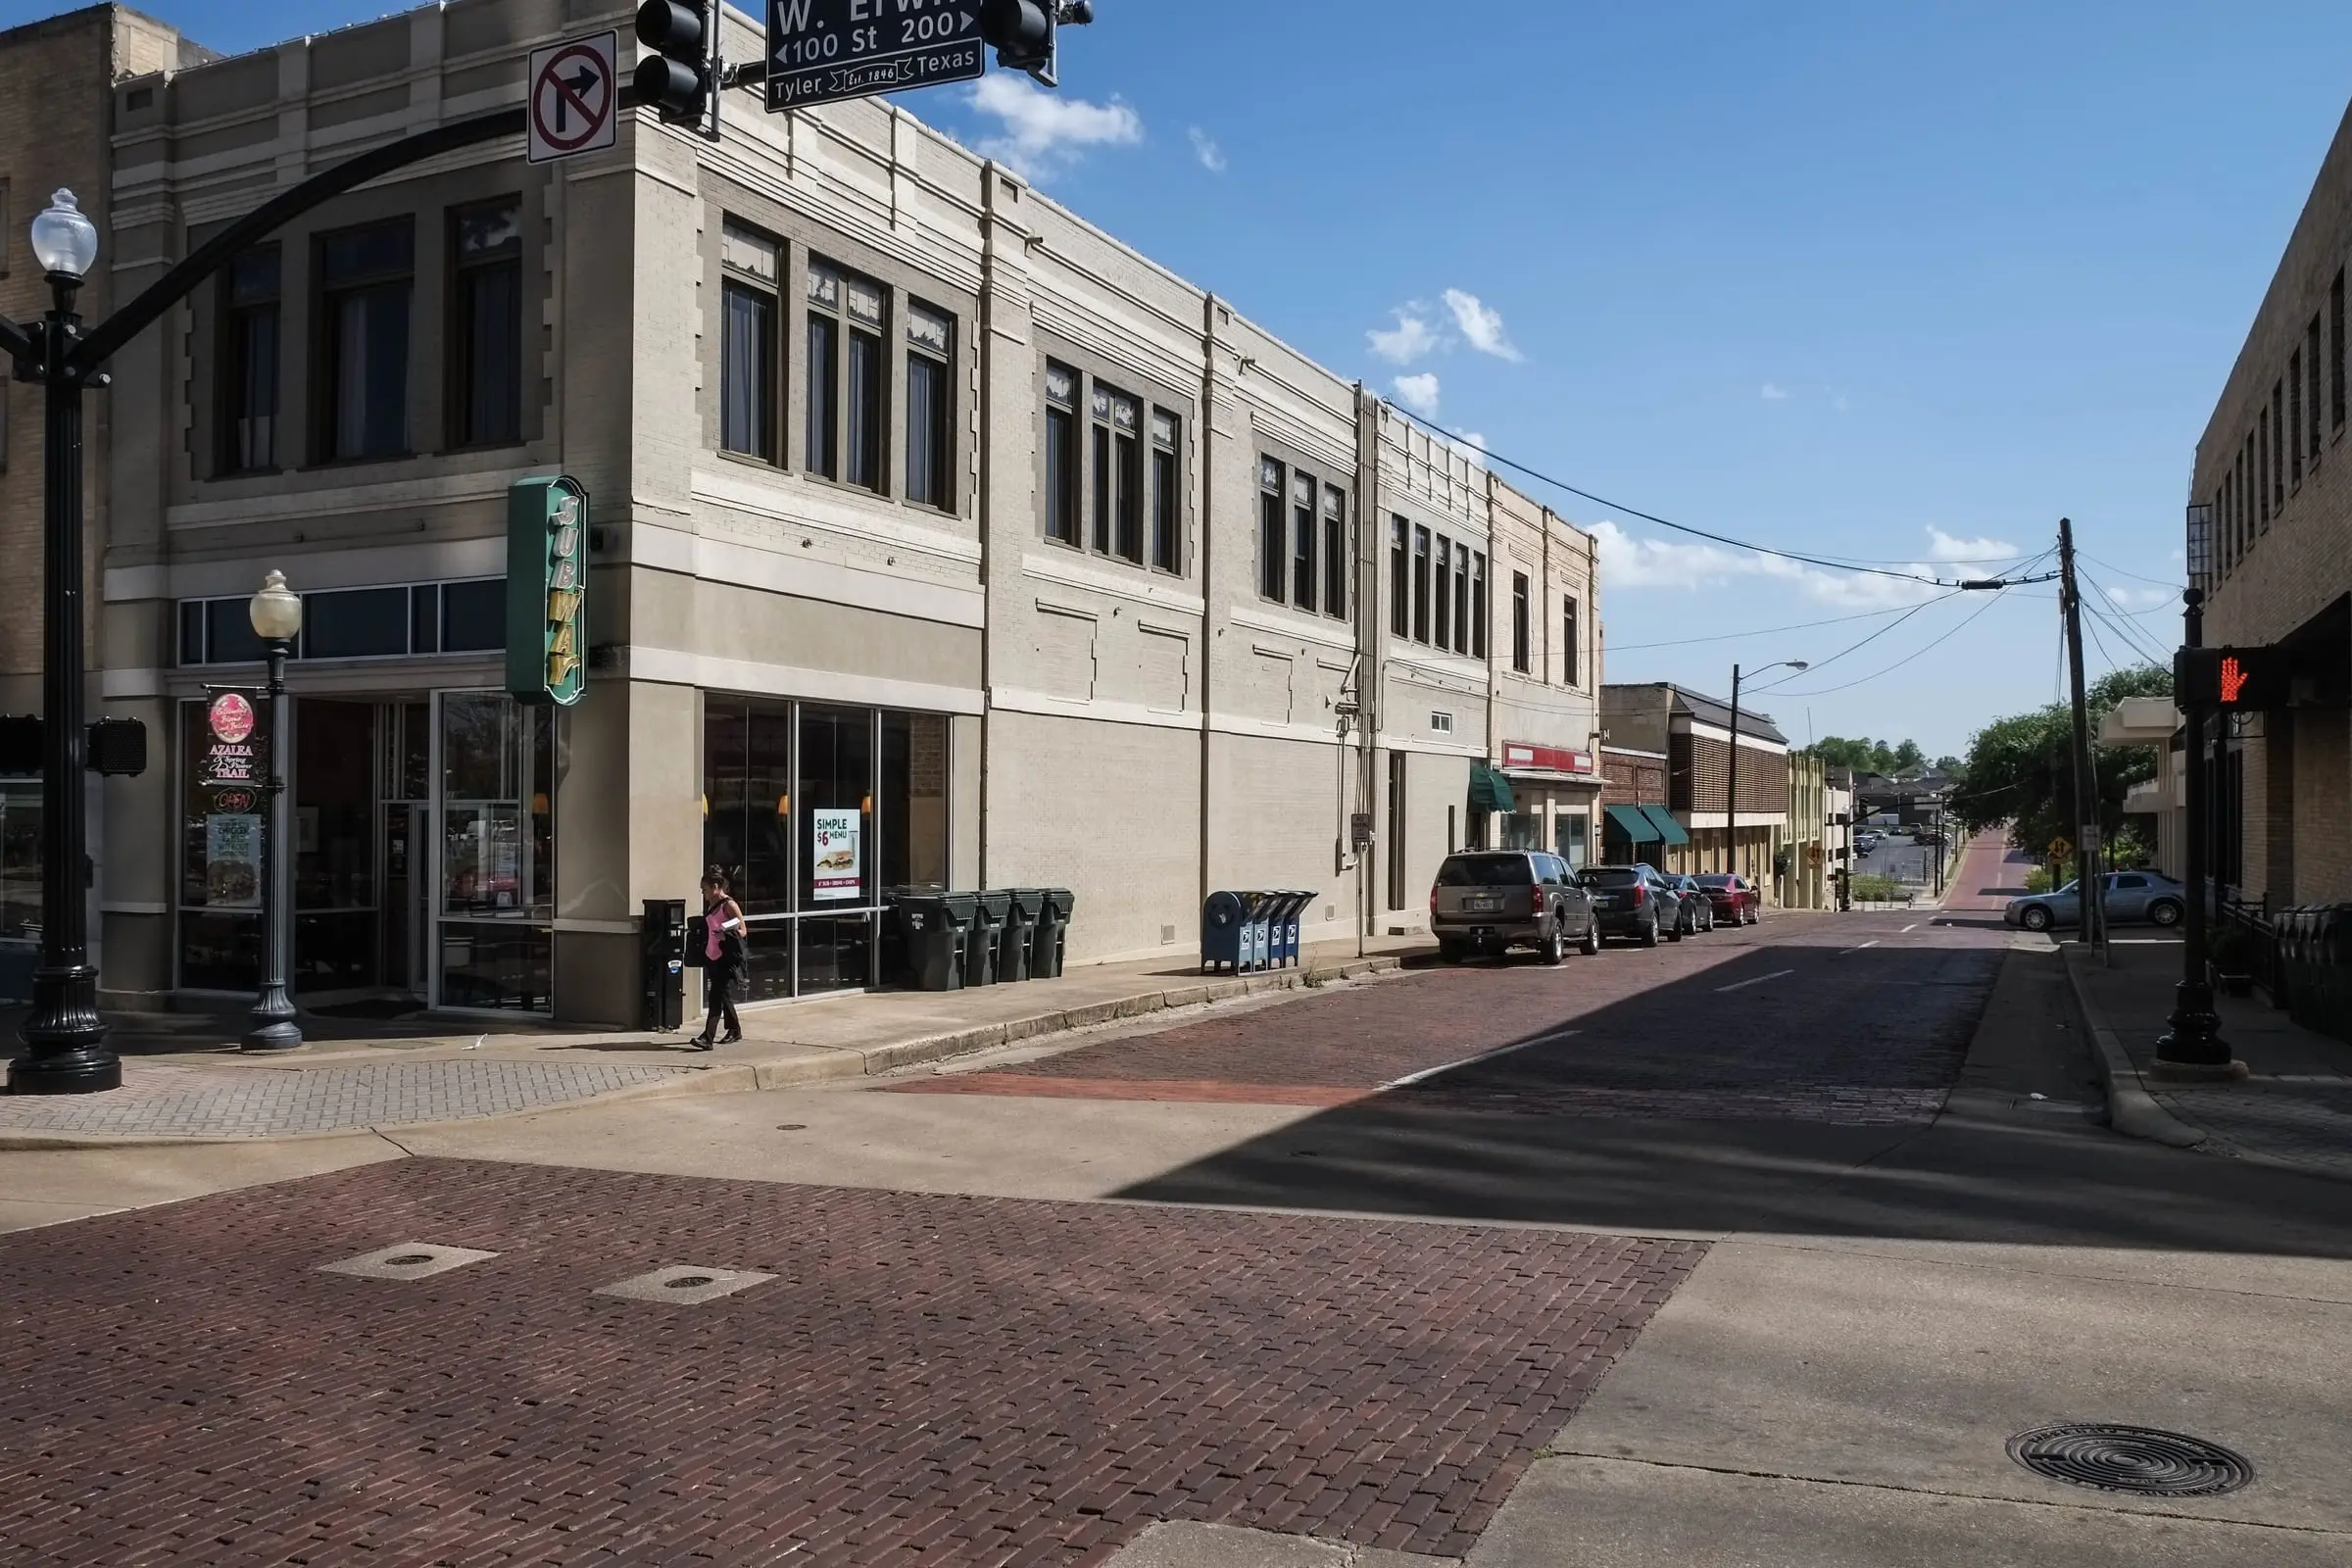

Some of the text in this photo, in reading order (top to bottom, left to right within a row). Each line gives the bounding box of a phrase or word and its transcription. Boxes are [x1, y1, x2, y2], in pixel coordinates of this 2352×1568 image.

[777, 0, 825, 35] W.
[793, 12, 954, 63] 100 St 200
[868, 68, 894, 82] 1846
[917, 51, 974, 73] Texas
[548, 495, 582, 686] SUBWAY
[209, 745, 253, 756] AZALEA
[816, 818, 848, 830] SIMPLE
[816, 830, 848, 846] $6 MENU
